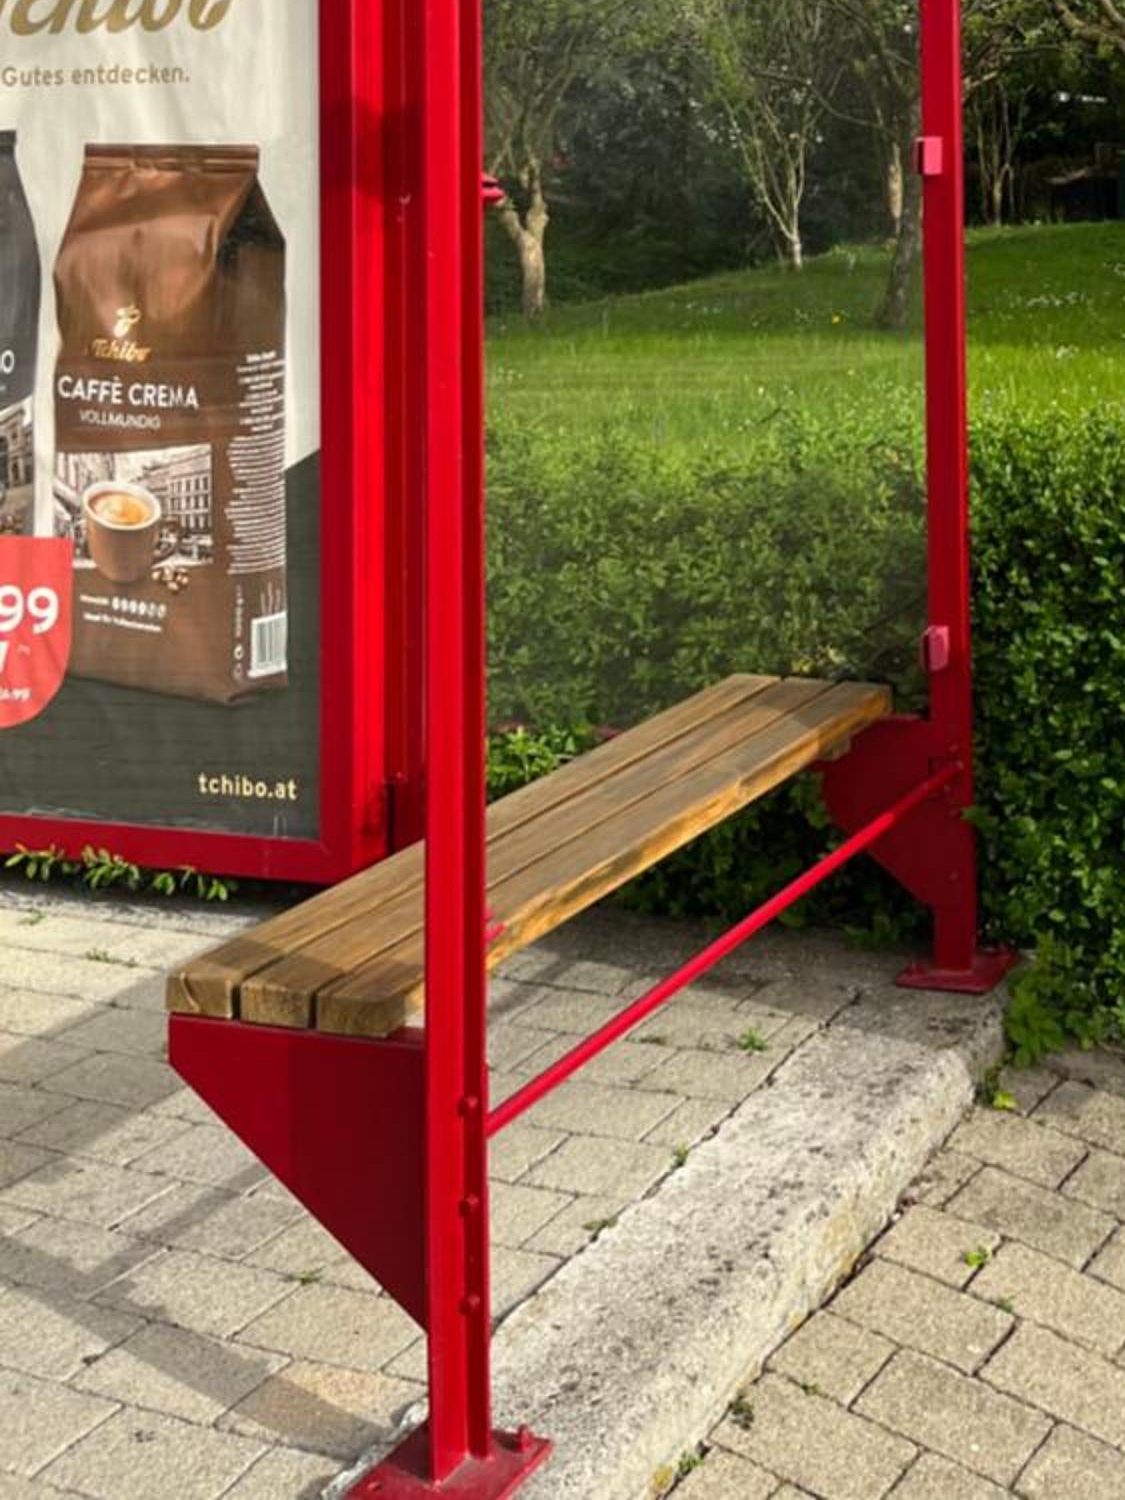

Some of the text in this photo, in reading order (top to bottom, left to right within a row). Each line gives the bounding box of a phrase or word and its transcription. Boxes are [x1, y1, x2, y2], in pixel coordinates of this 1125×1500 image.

[2, 64, 190, 86] Gutes entdecken.
[92, 338, 151, 362] Tchibo
[58, 375, 200, 410] CAFFÈ CREMA
[198, 772, 298, 800] tchibo.at
